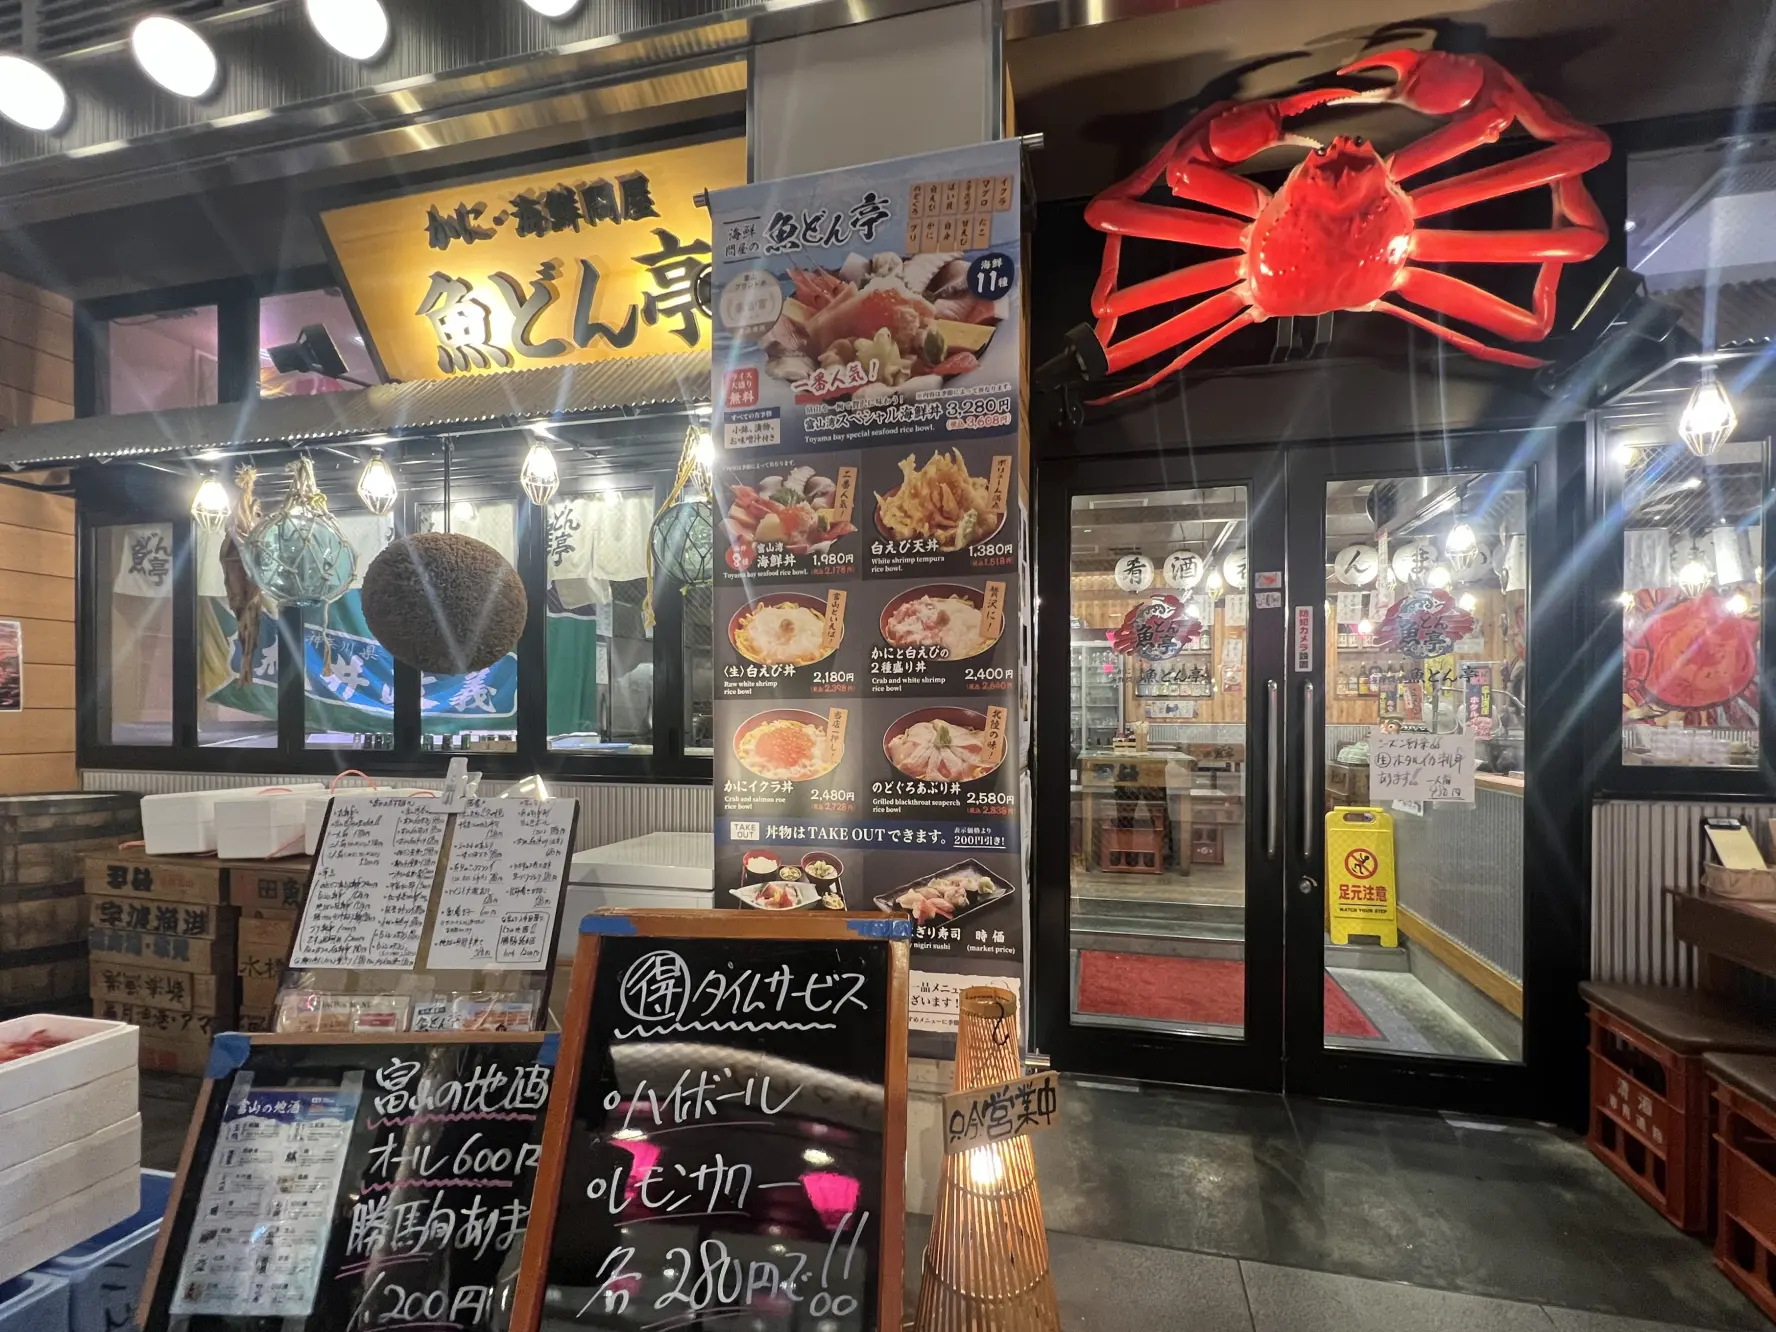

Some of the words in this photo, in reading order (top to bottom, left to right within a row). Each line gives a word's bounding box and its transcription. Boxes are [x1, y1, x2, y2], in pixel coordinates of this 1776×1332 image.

[981, 180, 990, 207] マグロ
[998, 178, 1008, 206] イクラ
[765, 192, 890, 253] 魚どん亭
[978, 218, 987, 237] たこ
[728, 223, 755, 241] 海鮮
[909, 224, 918, 242] ブリ
[926, 222, 935, 240] かに
[725, 242, 759, 257] 問屋の
[416, 228, 712, 373] 魚どん亭
[729, 390, 755, 404] 無料
[946, 398, 1010, 418] 3,280円
[804, 404, 942, 432] 富山湾スペシャル海鮮丼
[730, 434, 775, 445] お味噌汁付き
[805, 434, 831, 444] Toyama
[833, 433, 845, 442] bay
[847, 430, 869, 440] special
[871, 427, 899, 437] seafood
[900, 426, 913, 434] rice
[915, 424, 935, 432] bowl.
[871, 538, 939, 555] 白えび天丼
[968, 544, 1013, 557] 1,380円
[757, 554, 797, 568] 海鮮丼
[812, 553, 854, 566] 1,980円
[892, 556, 915, 564] shrimp
[917, 556, 944, 564] tempura
[1344, 549, 1371, 575] ん
[1411, 547, 1430, 575] ま
[746, 571, 757, 579] bay
[1123, 557, 1147, 585] 肴
[1171, 556, 1197, 581] 酒
[1299, 609, 1309, 668] 防犯カメラ設置
[871, 645, 949, 659] かにと白えびの
[871, 661, 927, 674] 2種盛り丼
[964, 668, 1014, 680] 2,400円
[756, 680, 778, 688] shrimp
[813, 671, 855, 683] 2,180円
[723, 780, 794, 794] かにイクラ丼
[872, 781, 961, 795] のどぐろあぶり丼
[810, 789, 855, 801] 2,480円
[873, 798, 894, 806] Grilled
[966, 793, 1015, 805] 2,580円
[734, 823, 756, 831] TAKE
[737, 831, 754, 839] OUT
[954, 836, 1005, 846] 200円引き!
[1339, 884, 1387, 901] 足元注意
[911, 926, 961, 940] ぎり寿司
[914, 943, 932, 951] nigiri
[911, 995, 959, 1008] ざいます!
[374, 1057, 550, 1115] 富山の地酒
[237, 1099, 301, 1115] 富山の地酒
[949, 1076, 1057, 1143] 只今営業中
